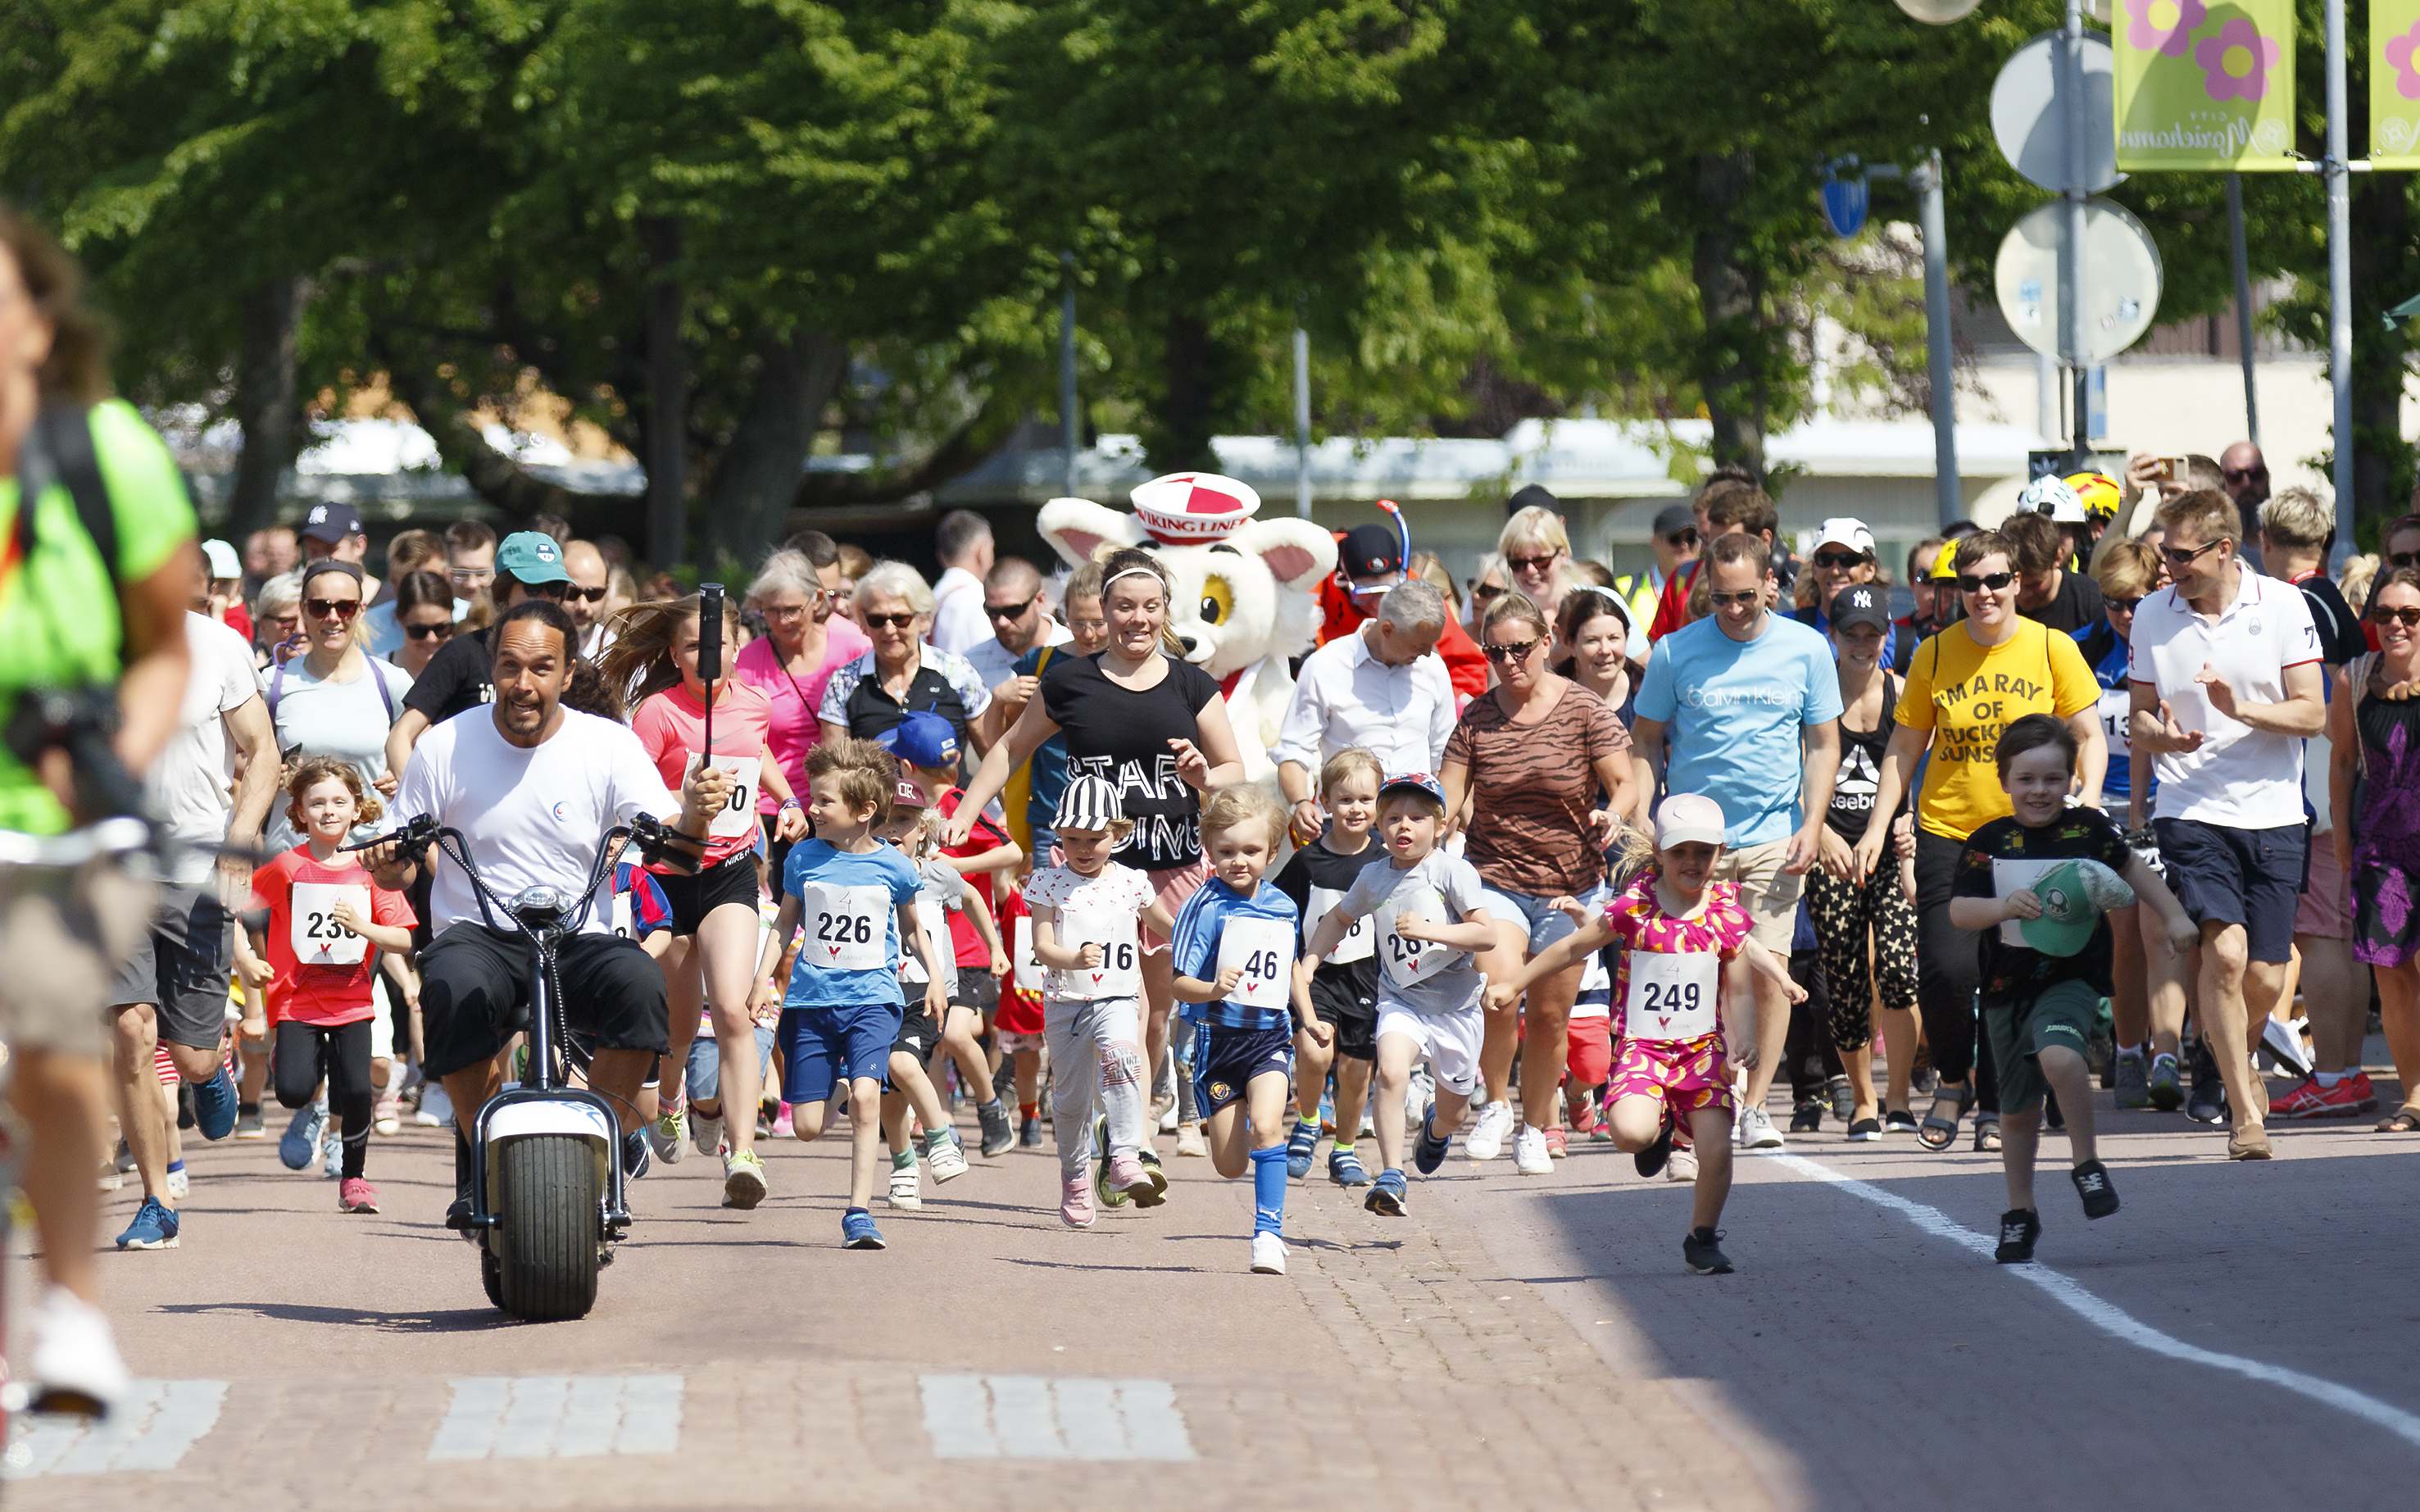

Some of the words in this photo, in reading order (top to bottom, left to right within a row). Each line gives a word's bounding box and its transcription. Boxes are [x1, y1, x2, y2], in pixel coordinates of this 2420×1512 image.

[1137, 508, 1196, 532] VIKING
[1200, 519, 1241, 532] LINE
[1853, 590, 1873, 608] NY
[1688, 686, 1750, 708] Calvin
[1754, 686, 1800, 706] Klein
[1934, 682, 1968, 708] I'M
[1973, 675, 1990, 695] A
[1995, 674, 2044, 702] RAY
[1973, 701, 2003, 720] OF
[1942, 722, 2010, 745] FUCKI
[724, 851, 744, 867] NIKE
[818, 912, 871, 944] 226
[1080, 942, 1133, 970] 16
[1245, 950, 1278, 980] 46
[1644, 983, 1700, 1012] 249
